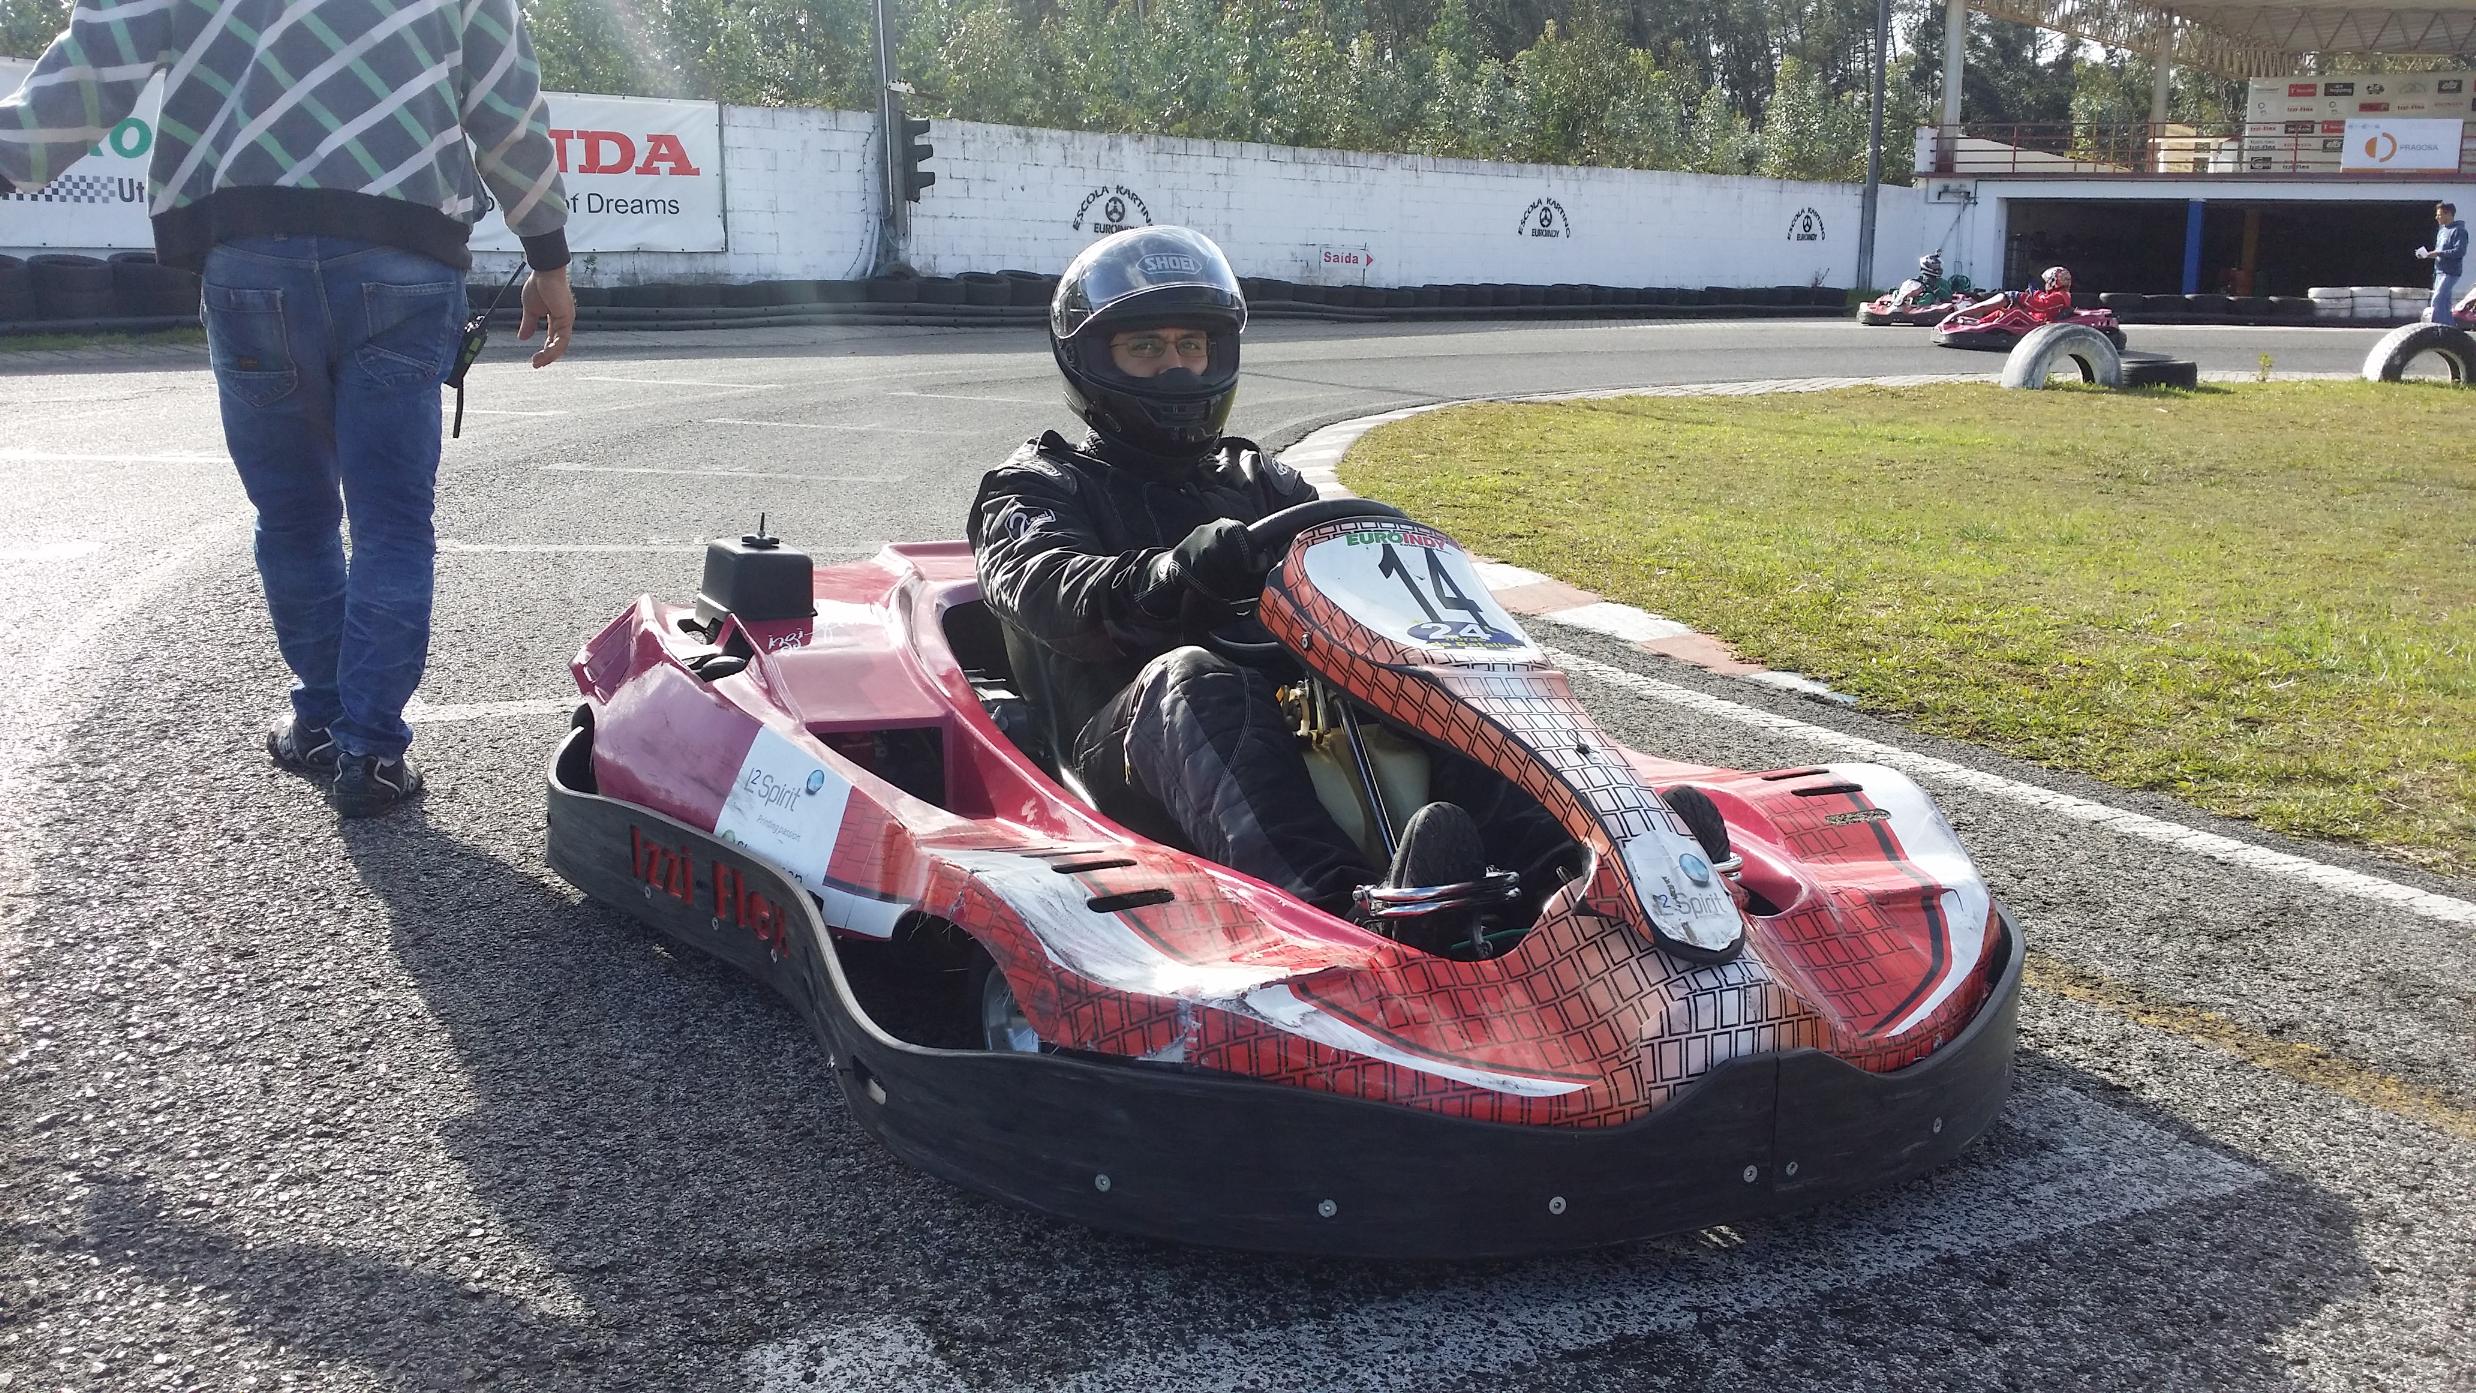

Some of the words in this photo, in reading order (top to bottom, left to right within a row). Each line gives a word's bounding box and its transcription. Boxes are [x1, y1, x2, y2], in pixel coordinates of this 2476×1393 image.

[588, 192, 680, 215] Dreams
[1073, 185, 1110, 231] ESCOLA
[1115, 184, 1154, 227] KARTIN
[1518, 198, 1543, 236] ESCOLA
[1547, 196, 1571, 239] KARTING
[1144, 256, 1195, 271] SHOEI
[1345, 531, 1446, 550] EUROINDY
[1377, 543, 1492, 632] 14
[1420, 622, 1493, 640] 24
